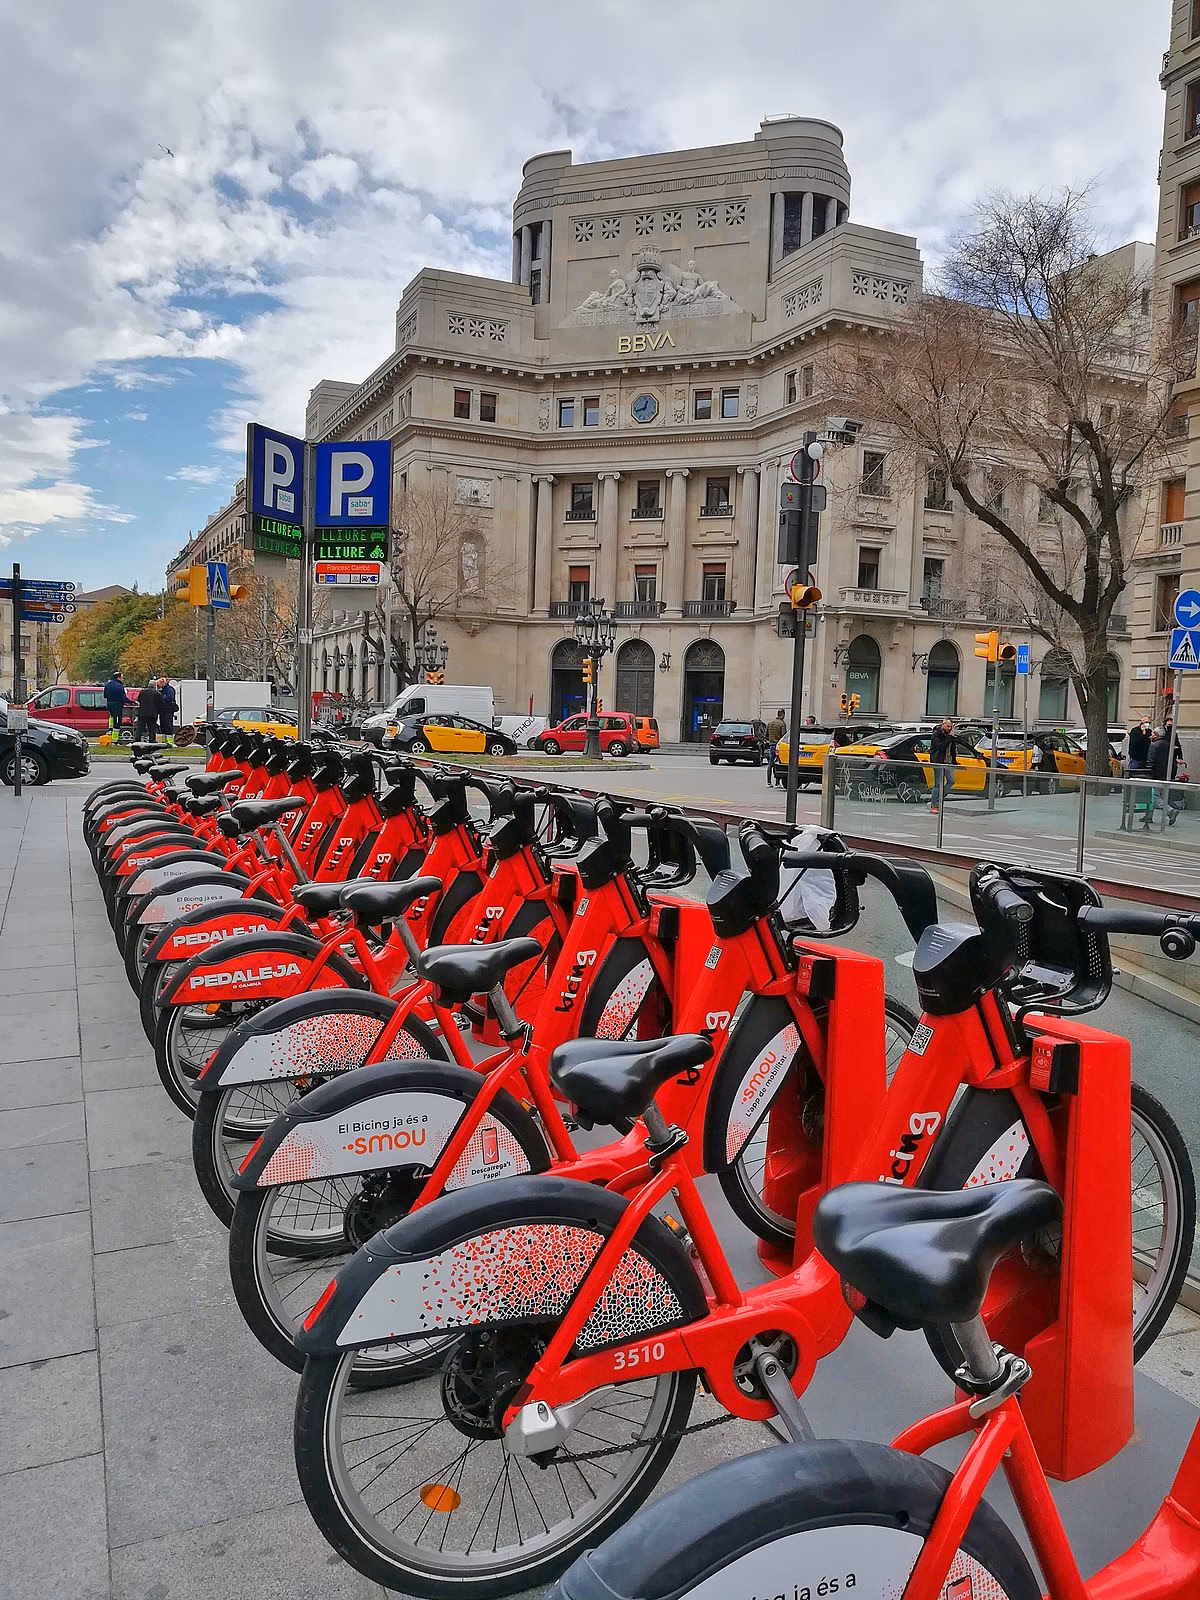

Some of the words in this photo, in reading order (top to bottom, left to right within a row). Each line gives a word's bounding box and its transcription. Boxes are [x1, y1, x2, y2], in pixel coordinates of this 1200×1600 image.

[618, 330, 676, 354] BBVA
[263, 438, 295, 508] P
[330, 451, 375, 516] P
[350, 499, 369, 508] saba
[261, 519, 292, 538] LLIURE
[321, 530, 367, 541] LLIURE
[320, 546, 366, 559] LLIURE
[850, 671, 870, 680] BBVA
[469, 906, 505, 944] icing
[190, 962, 301, 990] PEDALEJA
[555, 950, 597, 1012] bicing
[744, 1051, 777, 1100] smou
[758, 1087, 767, 1098] de
[765, 1055, 787, 1088] mobilitat
[338, 1124, 349, 1134] El
[353, 1119, 390, 1132] Bicing
[392, 1116, 404, 1129] ja
[406, 1113, 418, 1125] és
[421, 1115, 428, 1123] a
[354, 1126, 426, 1155] smou
[879, 1112, 941, 1185] icing
[471, 1161, 511, 1176] Descarrega't
[613, 1342, 665, 1371] 3510
[816, 1576, 840, 1597] és
[845, 1572, 857, 1588] a
